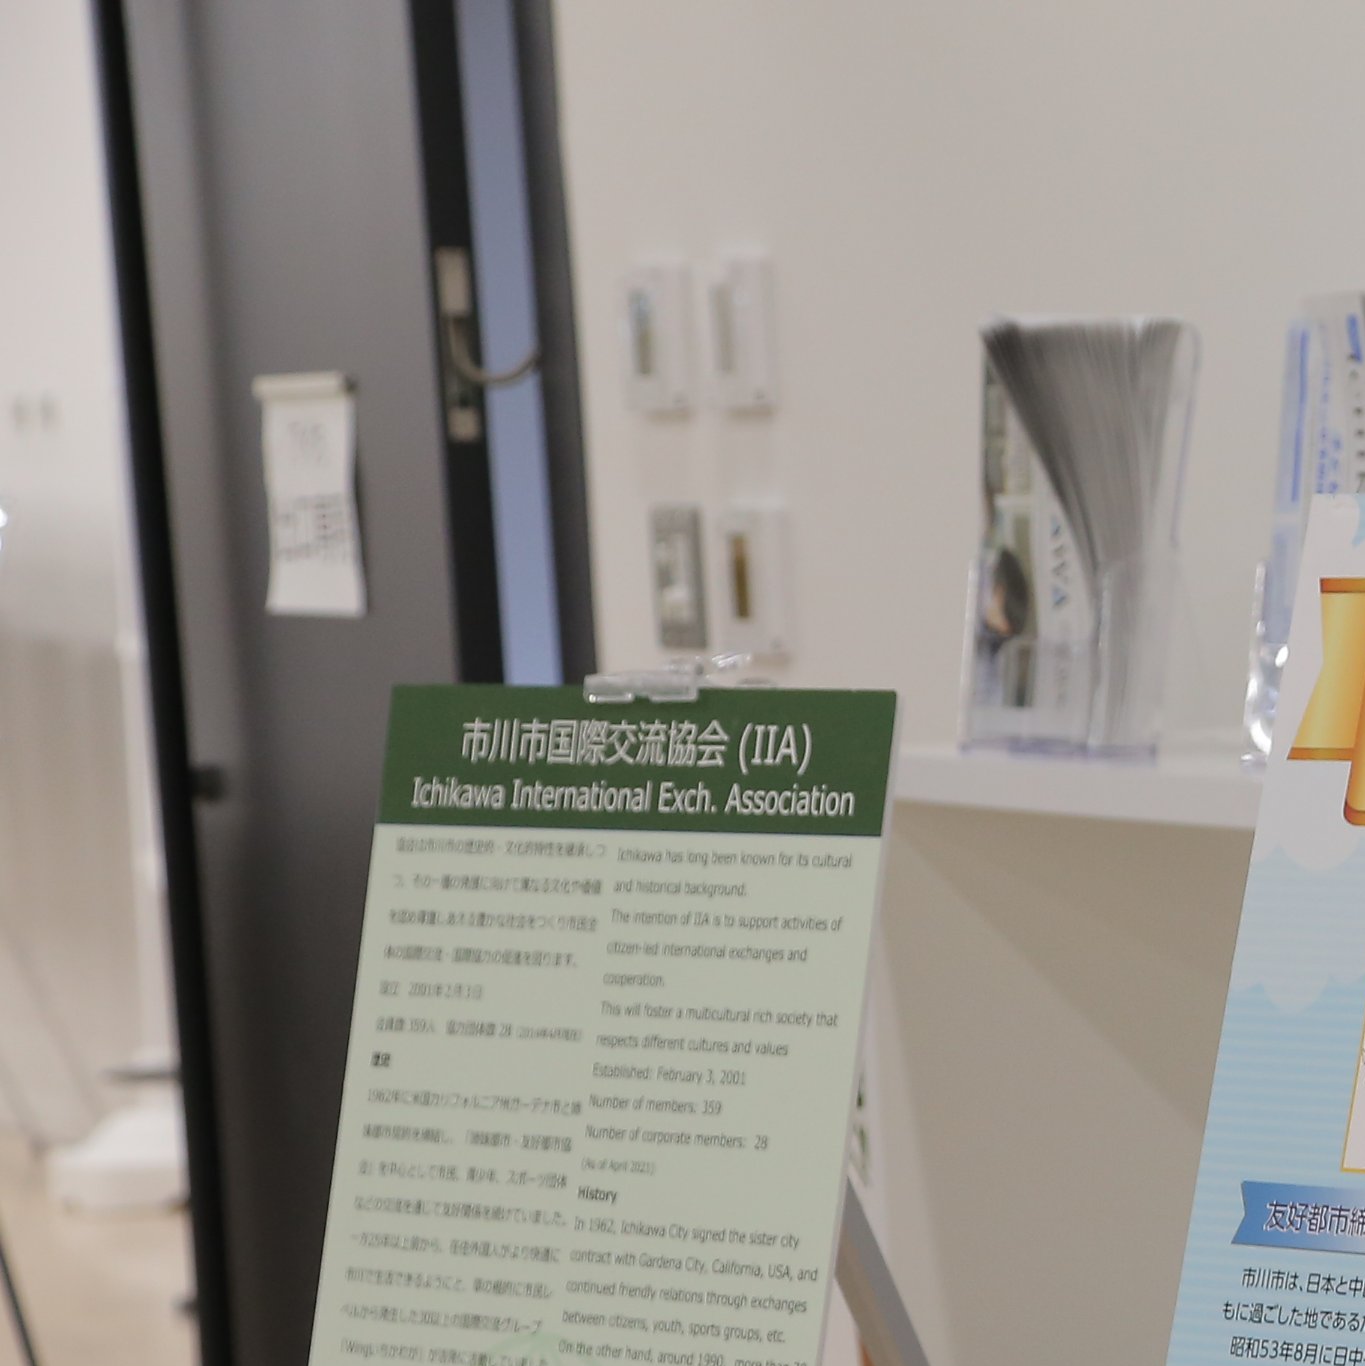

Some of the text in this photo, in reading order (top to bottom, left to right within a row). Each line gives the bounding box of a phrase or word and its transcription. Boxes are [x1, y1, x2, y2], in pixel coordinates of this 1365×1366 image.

[458, 716, 815, 775] 市川市国際交流協会 (IIA)
[410, 776, 858, 817] Ichikawa International Exch. Association
[753, 1134, 768, 1149] 28
[576, 1184, 617, 1204] History
[620, 1218, 666, 1238] Ichikawa
[667, 1223, 688, 1241] City
[727, 1227, 746, 1244] the
[780, 1232, 800, 1251] city
[657, 1347, 694, 1366] around
